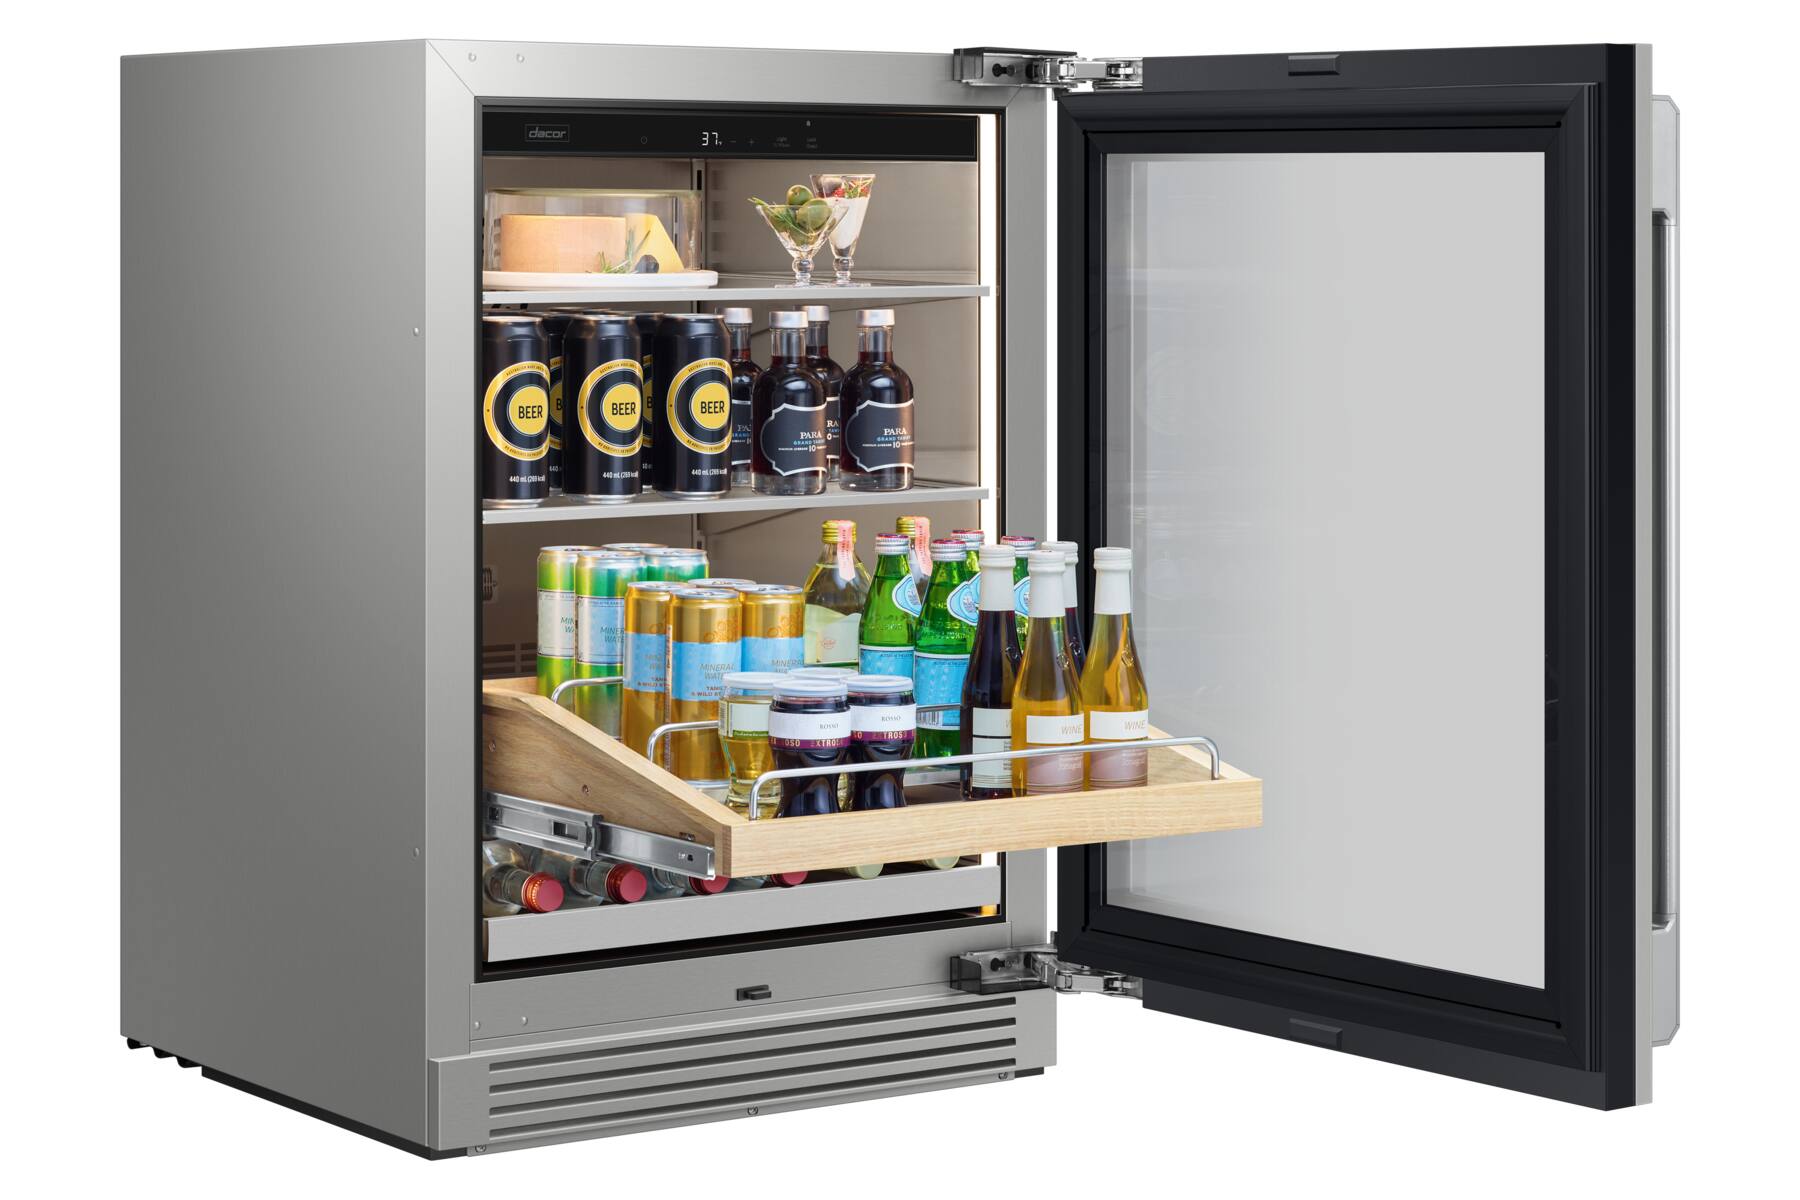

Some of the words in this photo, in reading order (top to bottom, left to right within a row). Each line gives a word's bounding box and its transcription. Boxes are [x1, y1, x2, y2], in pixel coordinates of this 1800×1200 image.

[528, 126, 567, 138] dacor
[518, 405, 543, 419] BEER
[611, 402, 636, 415] BEER
[700, 400, 725, 414] BEER
[800, 430, 822, 439] PARA
[884, 427, 907, 435] PARA
[600, 626, 624, 634] MINER
[604, 635, 624, 643] WATE
[1061, 724, 1083, 735] WINE
[1124, 720, 1146, 730] WINE
